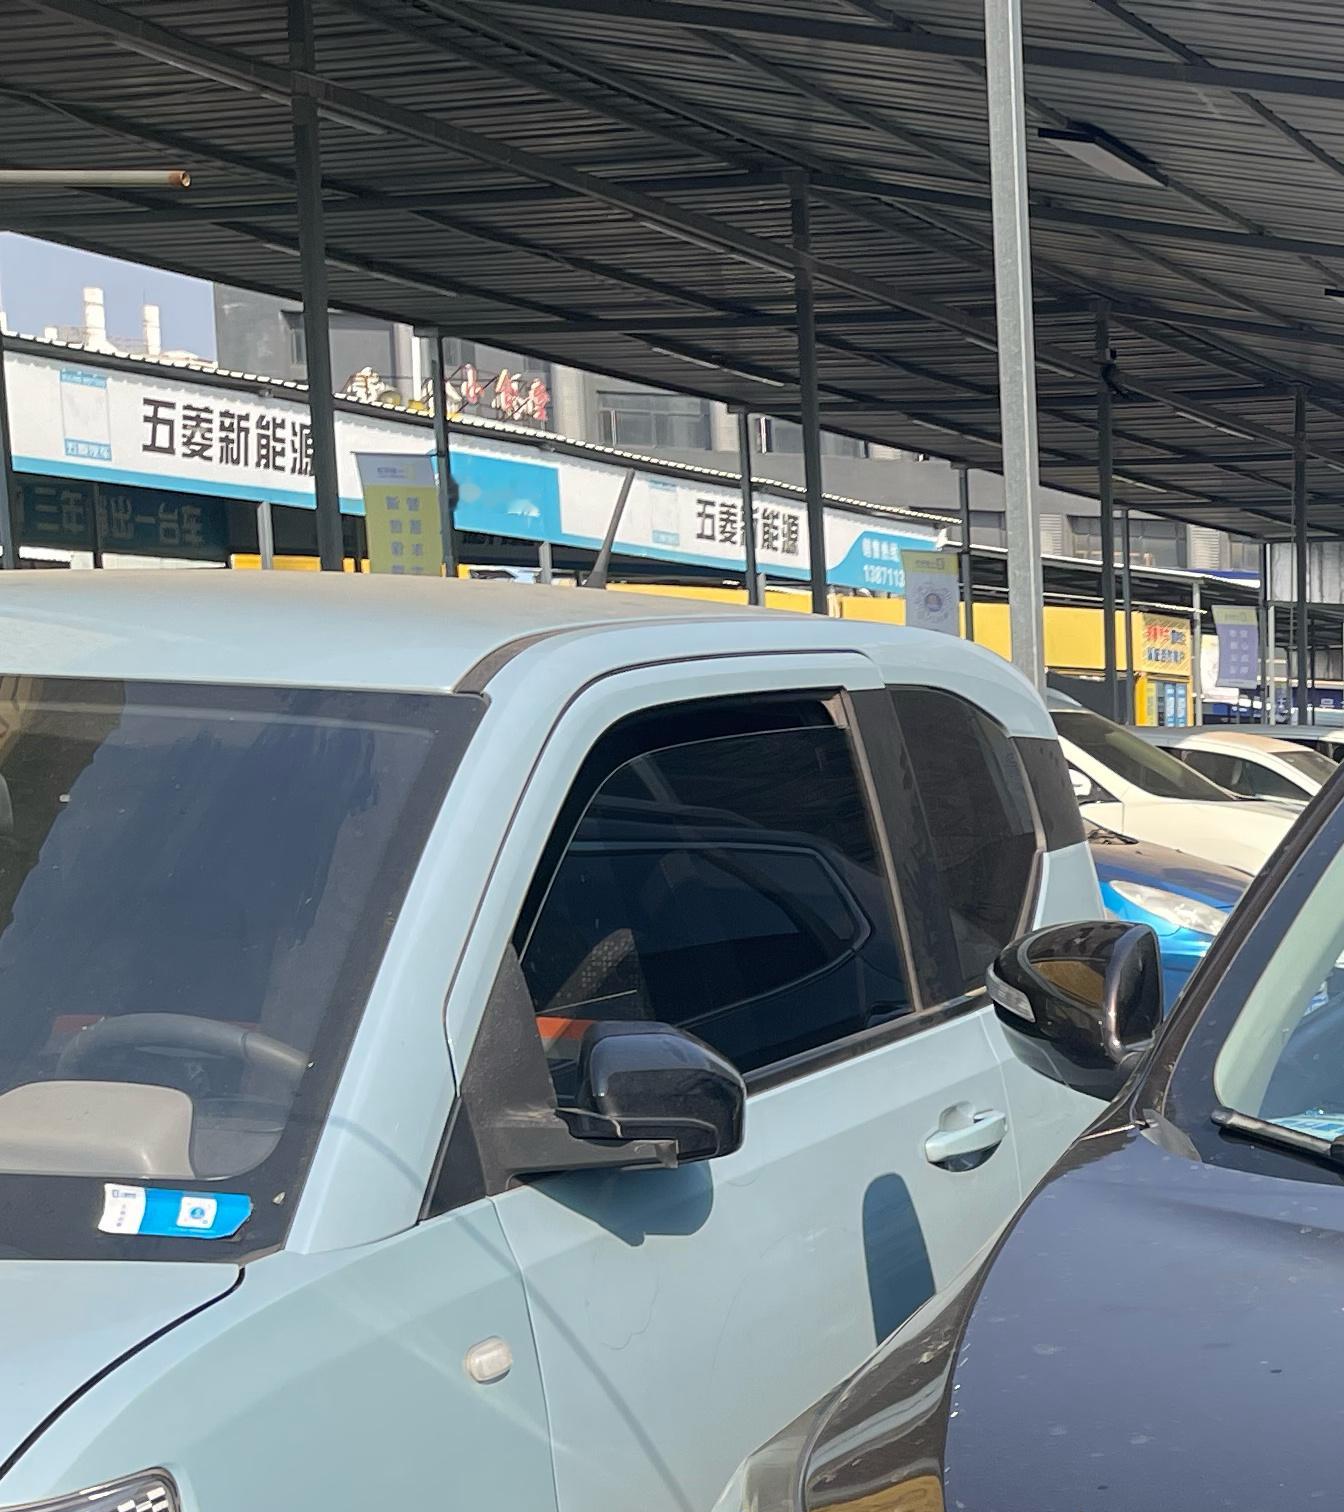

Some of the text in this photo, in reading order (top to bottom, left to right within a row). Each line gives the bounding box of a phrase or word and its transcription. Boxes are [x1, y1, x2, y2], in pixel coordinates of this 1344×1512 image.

[142, 398, 314, 477] 五菱新能源
